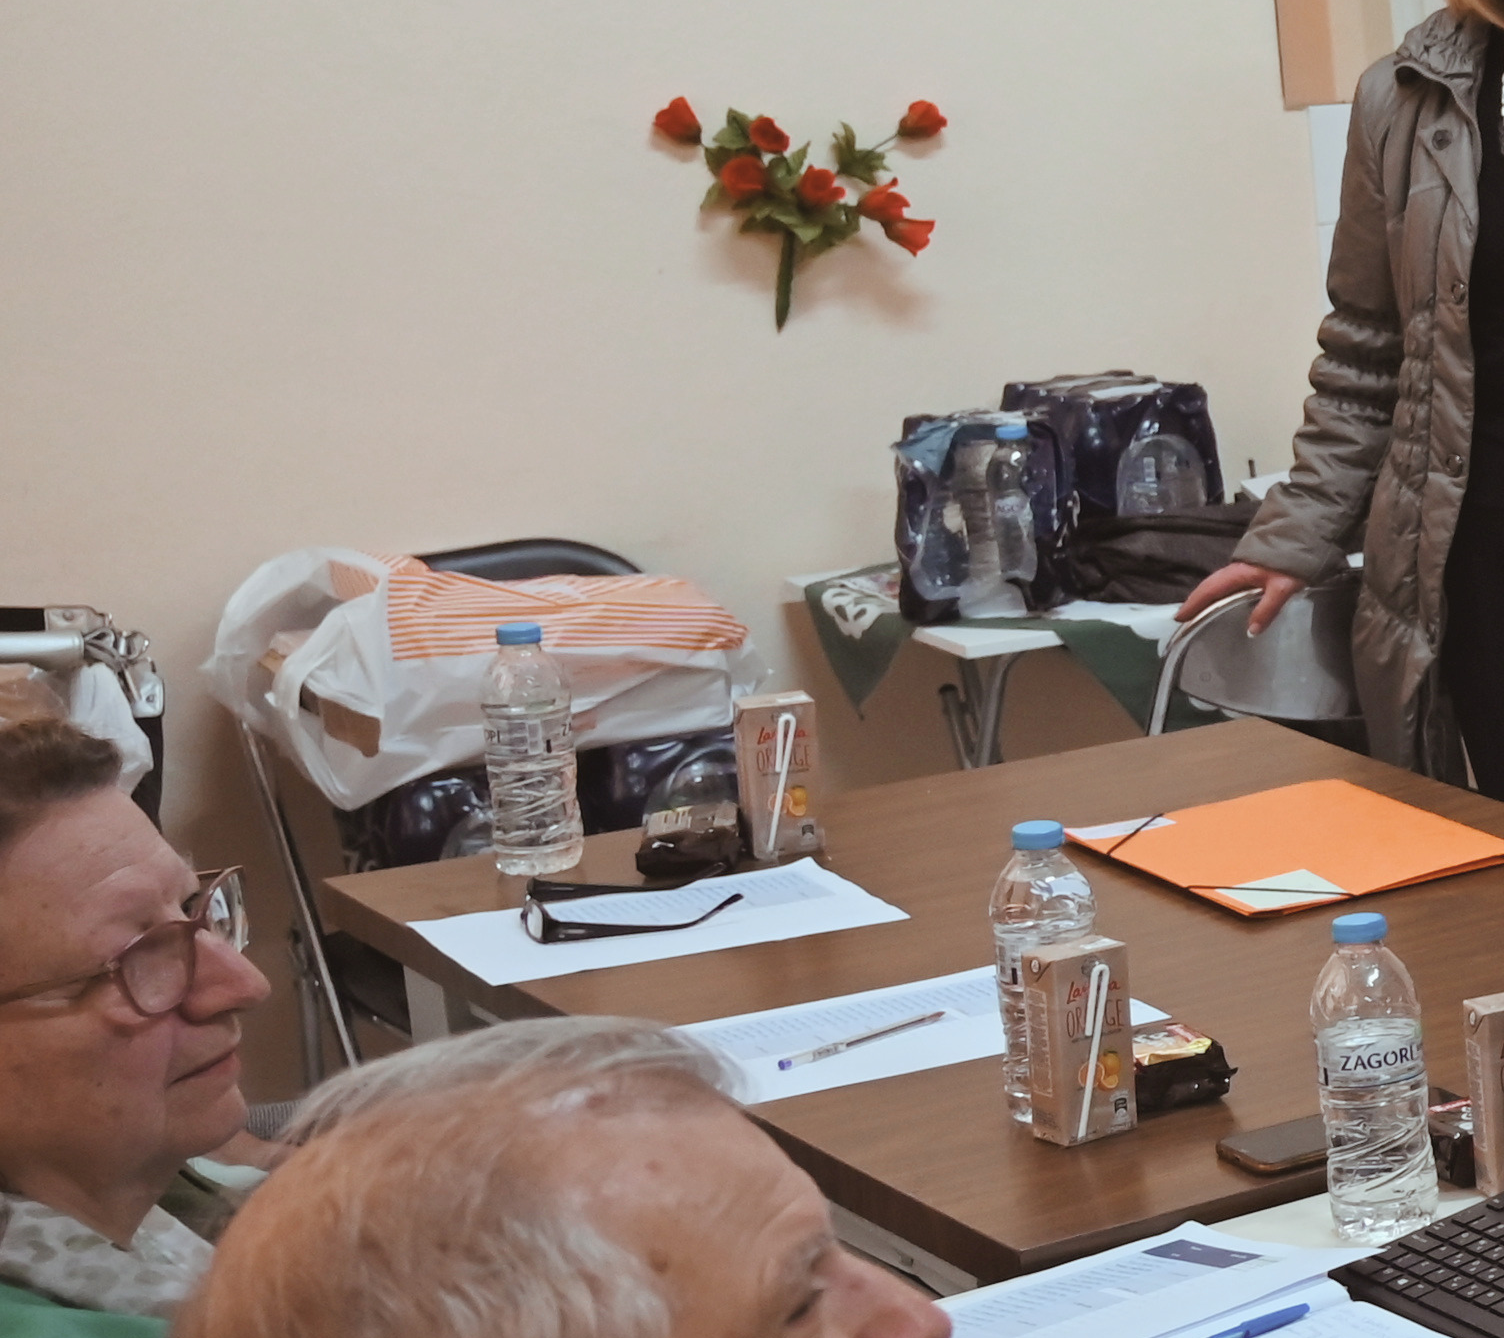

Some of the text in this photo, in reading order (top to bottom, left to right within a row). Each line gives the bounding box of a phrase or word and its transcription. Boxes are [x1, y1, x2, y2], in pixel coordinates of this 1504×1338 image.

[756, 744, 810, 773] ORGE
[1066, 999, 1124, 1038] ORGE
[1340, 1044, 1416, 1072] ZAGORI
